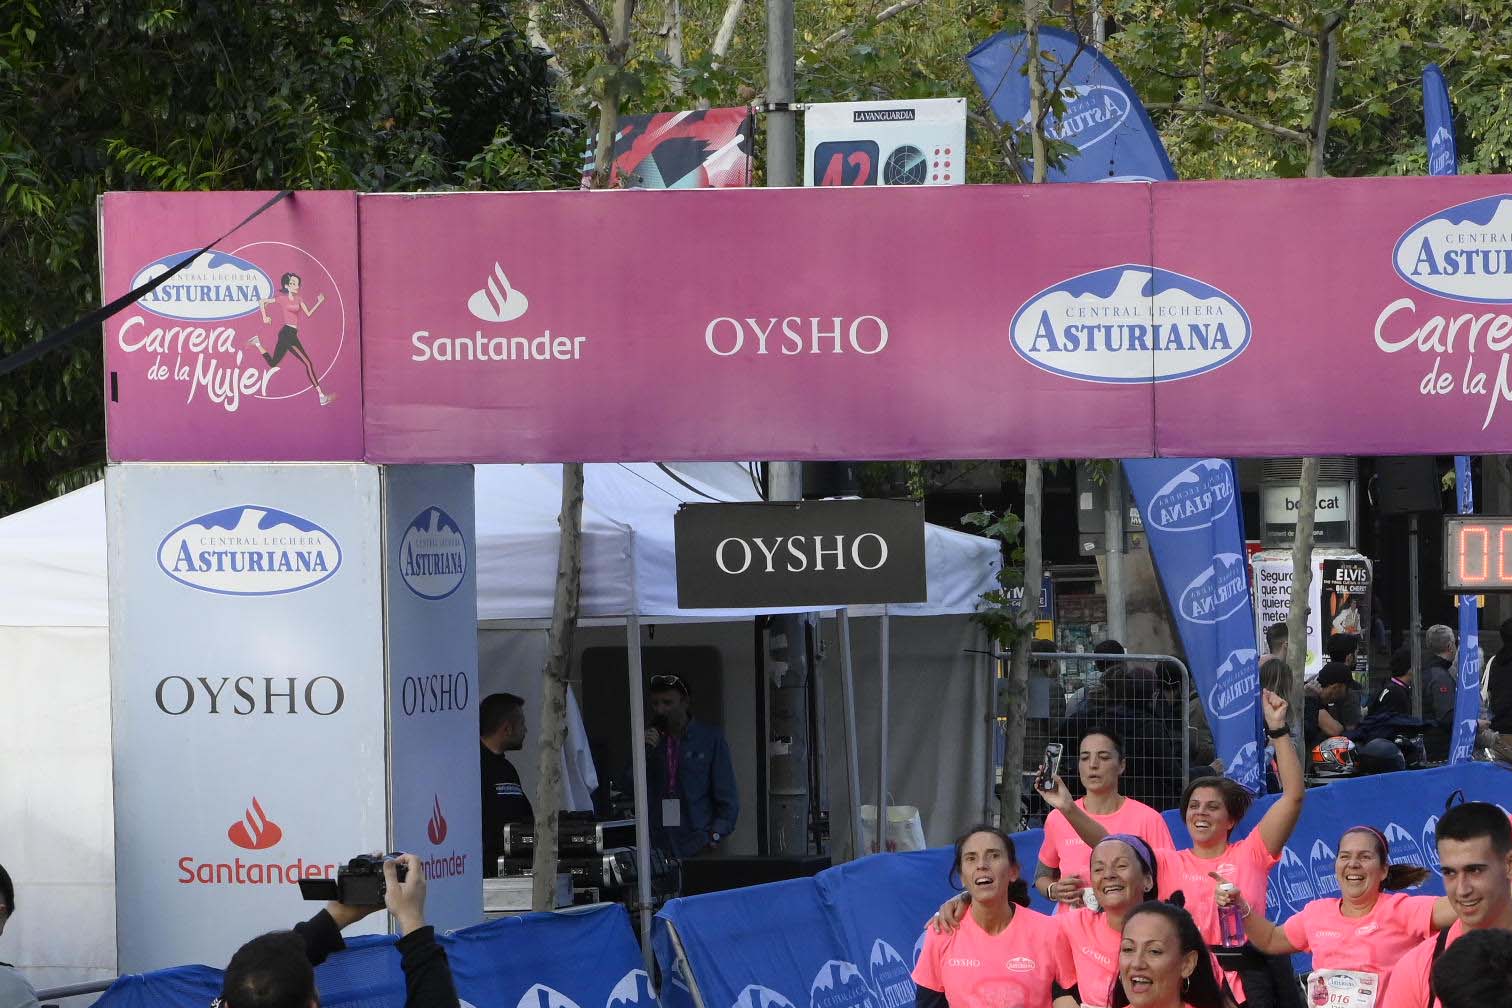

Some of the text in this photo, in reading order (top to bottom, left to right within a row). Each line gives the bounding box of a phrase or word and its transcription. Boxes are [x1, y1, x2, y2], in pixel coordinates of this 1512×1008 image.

[865, 110, 914, 121] VANGUARDIA
[170, 273, 258, 282] ENTRAL LECHERA
[1065, 305, 1225, 317] CENTRAL LECHERA
[118, 316, 237, 353] Carrera
[411, 330, 586, 362] Santander
[705, 315, 890, 356] OYSHO
[1028, 310, 1233, 352] ASTURIANA
[148, 350, 281, 412] de la Mujer
[1419, 356, 1455, 395] de
[1462, 355, 1488, 395] la
[172, 539, 329, 573] ASTURIANA
[200, 537, 322, 546] CENTRAL LECHERA
[715, 532, 889, 575] OYSHO
[405, 541, 463, 577] ASTURIANA
[1336, 569, 1367, 581] ELVIS
[1261, 585, 1278, 597] que
[1262, 597, 1293, 609] quiere
[155, 675, 345, 716] OYSHO
[402, 671, 469, 716] OYSHO
[178, 856, 334, 885] Santander
[949, 958, 980, 967] OYSHO
[1330, 993, 1350, 1004] 016
